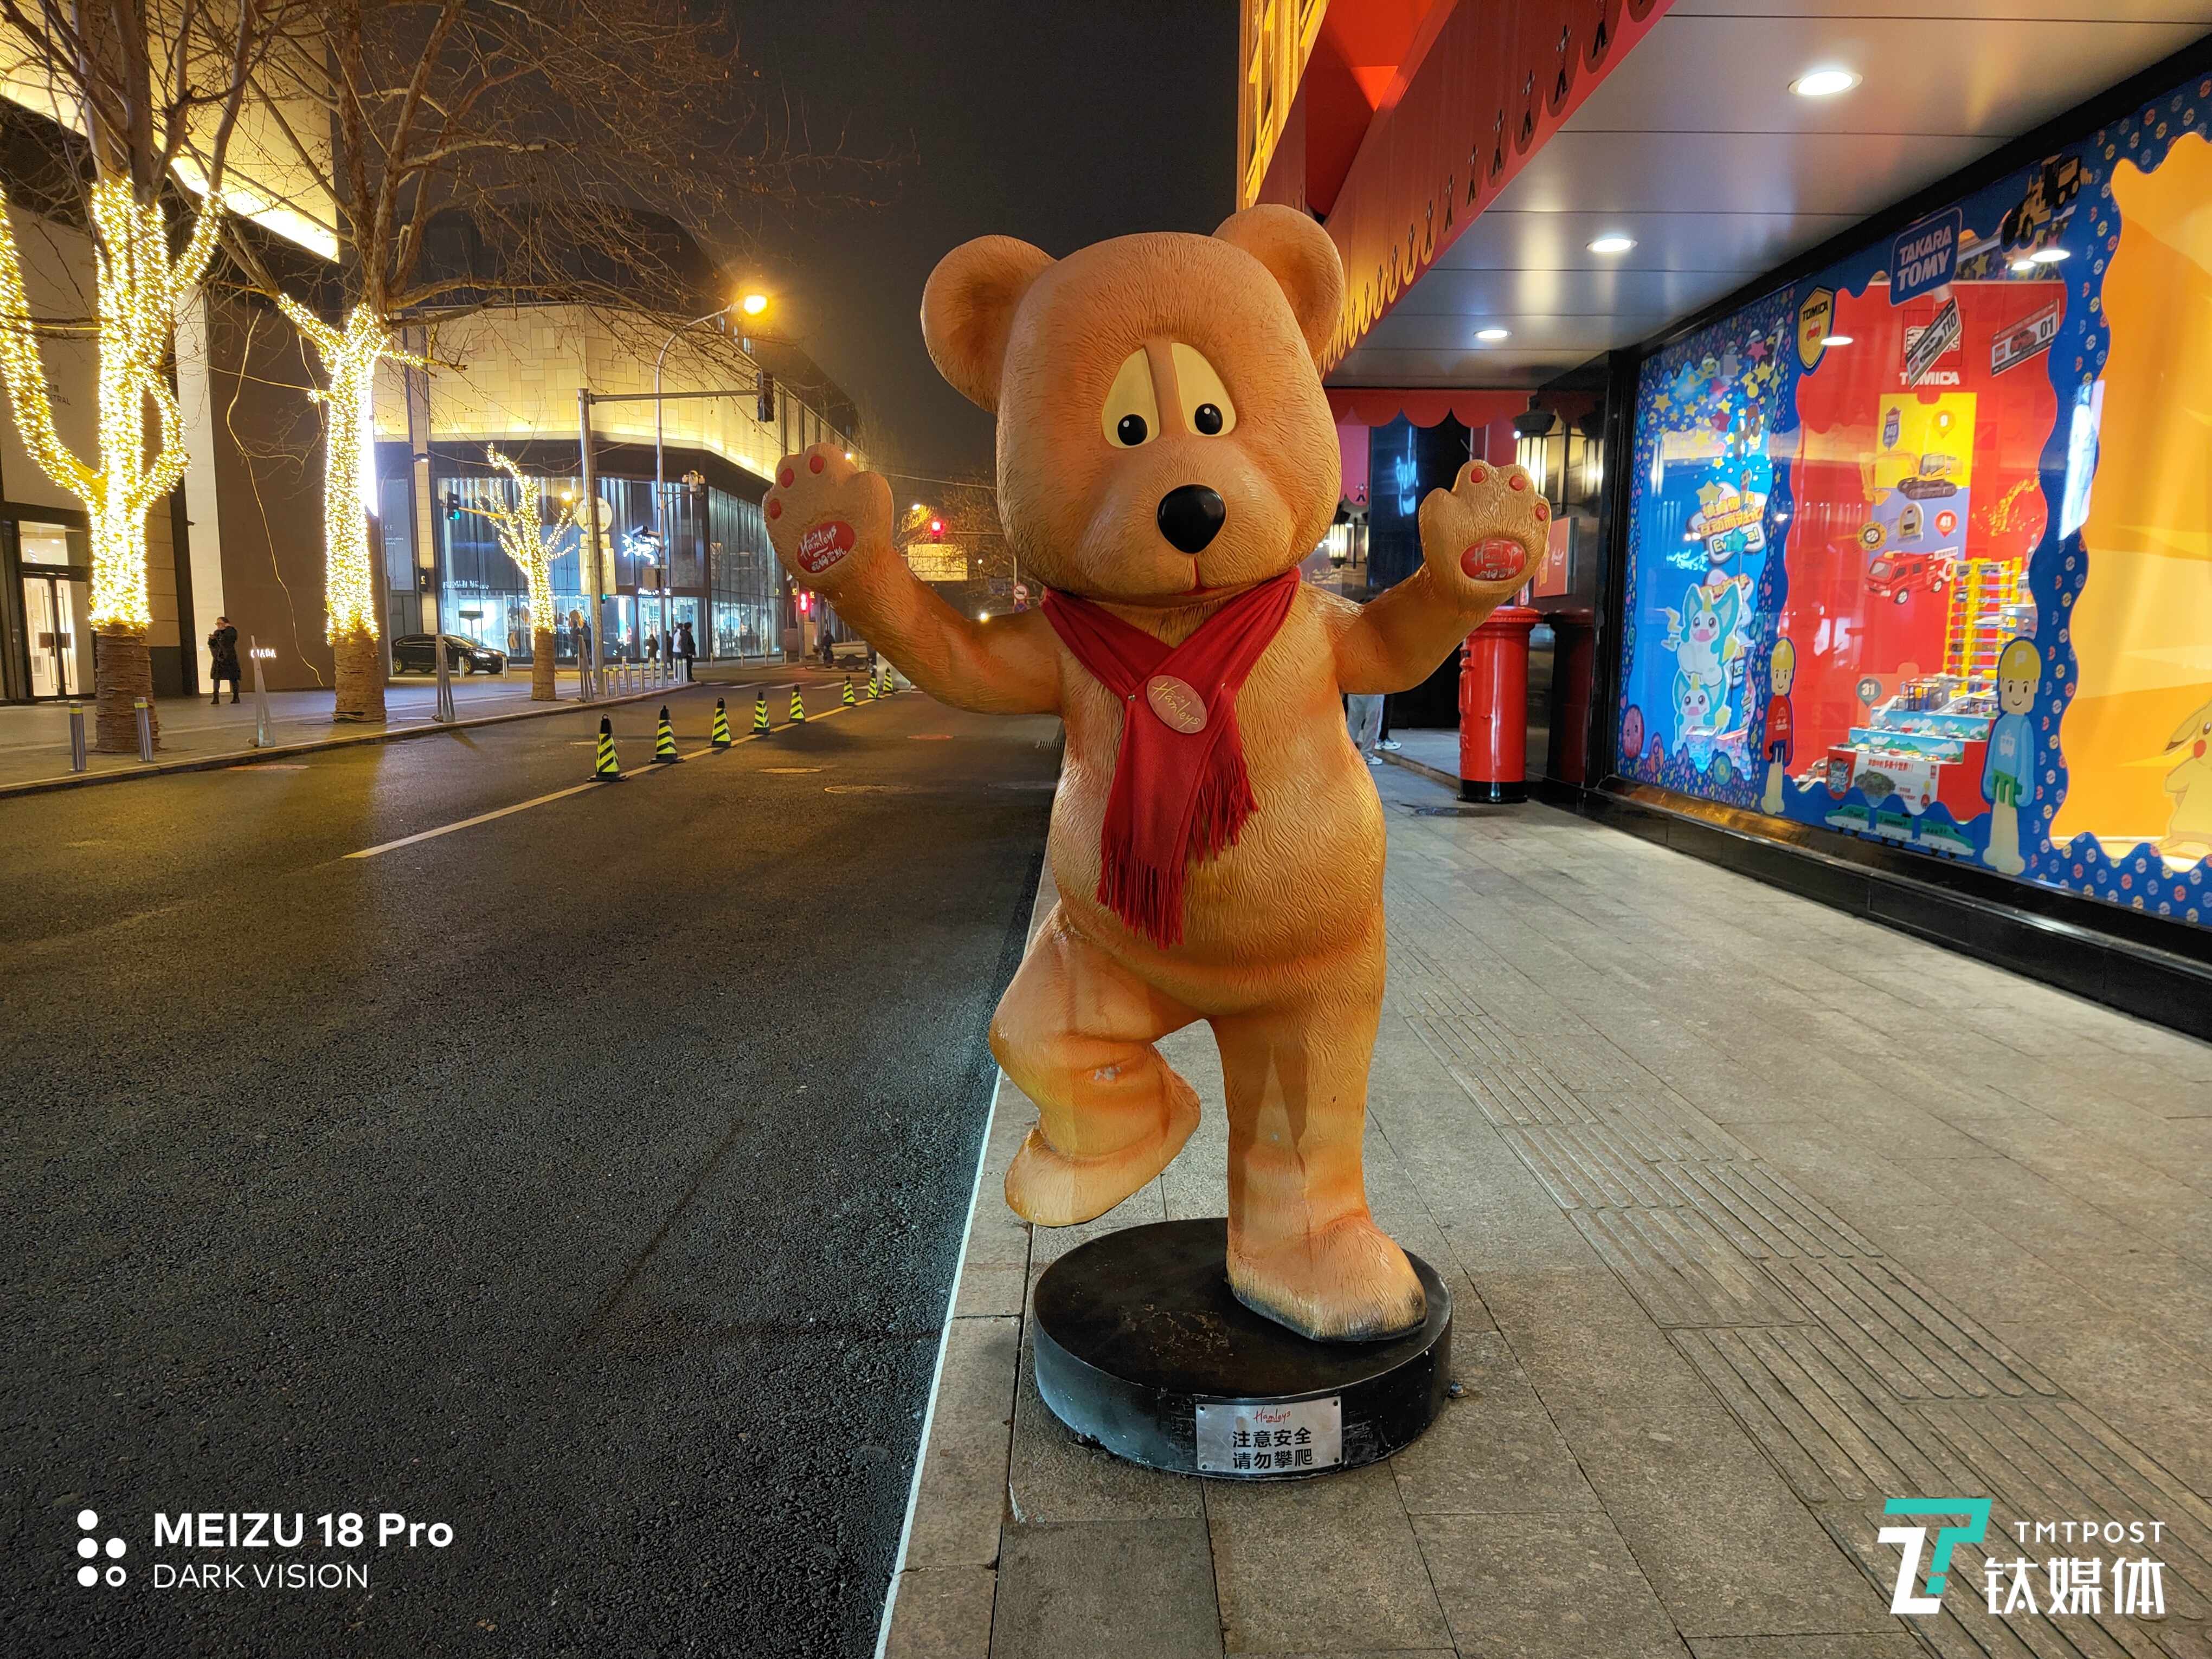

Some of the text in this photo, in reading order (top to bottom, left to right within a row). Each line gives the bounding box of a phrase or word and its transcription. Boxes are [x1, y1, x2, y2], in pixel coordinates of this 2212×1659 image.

[1899, 225, 1952, 267] TAKARA
[1898, 247, 1951, 292] TOMY
[1802, 300, 1828, 323] TOMICA
[1941, 309, 1957, 337] 110
[2040, 316, 2054, 338] 01
[1899, 371, 1960, 385] TMICA
[1939, 515, 1952, 528] 41
[800, 525, 837, 561] Hamleys
[1861, 683, 1876, 696] 31
[1152, 681, 1201, 729] Hamleys
[1253, 1406, 1291, 1424] Hamleys
[1232, 1426, 1312, 1448] 注意安全
[1233, 1448, 1313, 1470] 请勿攀爬
